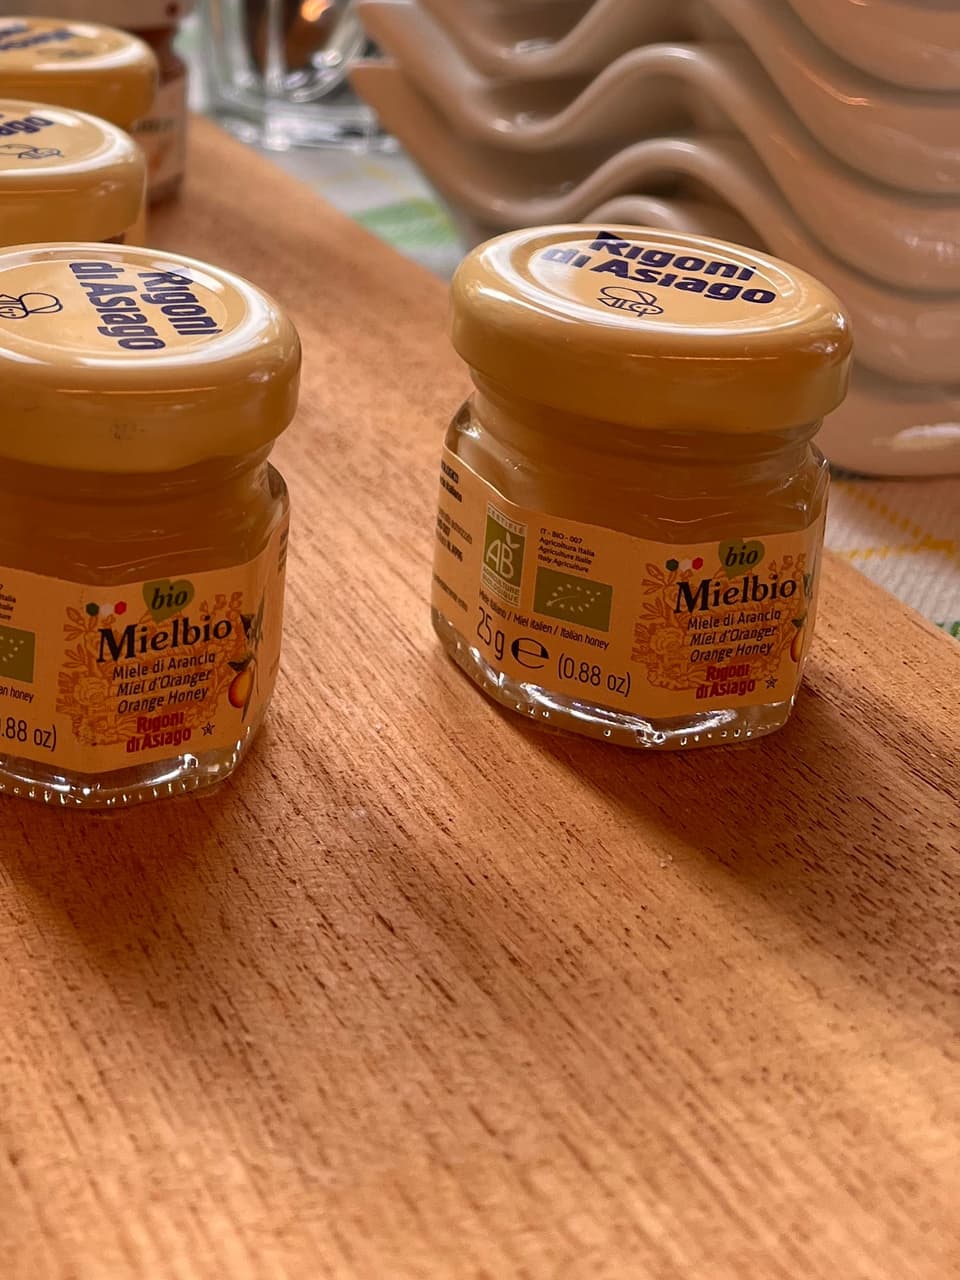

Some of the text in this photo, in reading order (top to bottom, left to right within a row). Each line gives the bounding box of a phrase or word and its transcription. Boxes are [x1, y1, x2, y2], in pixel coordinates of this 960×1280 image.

[588, 231, 758, 282] Rigoni
[540, 247, 776, 305] di Asiago
[68, 261, 166, 351] di Asiago
[137, 271, 223, 336] Rigoni
[486, 539, 514, 579] AB
[724, 544, 758, 568] bio
[152, 586, 188, 610] bio
[673, 573, 797, 615] Mielbio
[513, 613, 529, 627] Miel
[584, 634, 610, 651] honey
[688, 607, 782, 631] Miele di Arancio
[96, 615, 232, 663] Mielbio
[477, 606, 492, 646] 25
[494, 630, 505, 661] g
[558, 653, 601, 686] (0.88
[607, 671, 631, 698] oz)
[690, 631, 717, 647] Miel
[112, 651, 216, 680] Miele di Arancio
[690, 642, 775, 663] Orange Honey
[706, 663, 750, 681] Rigoni
[9, 686, 35, 704] honey
[117, 679, 145, 696] Miel
[117, 687, 209, 713] Orange Honey
[695, 679, 756, 700] di Asiago
[136, 711, 184, 733] Rigoni
[33, 724, 56, 752] oz)
[126, 727, 191, 753] di Asiago
